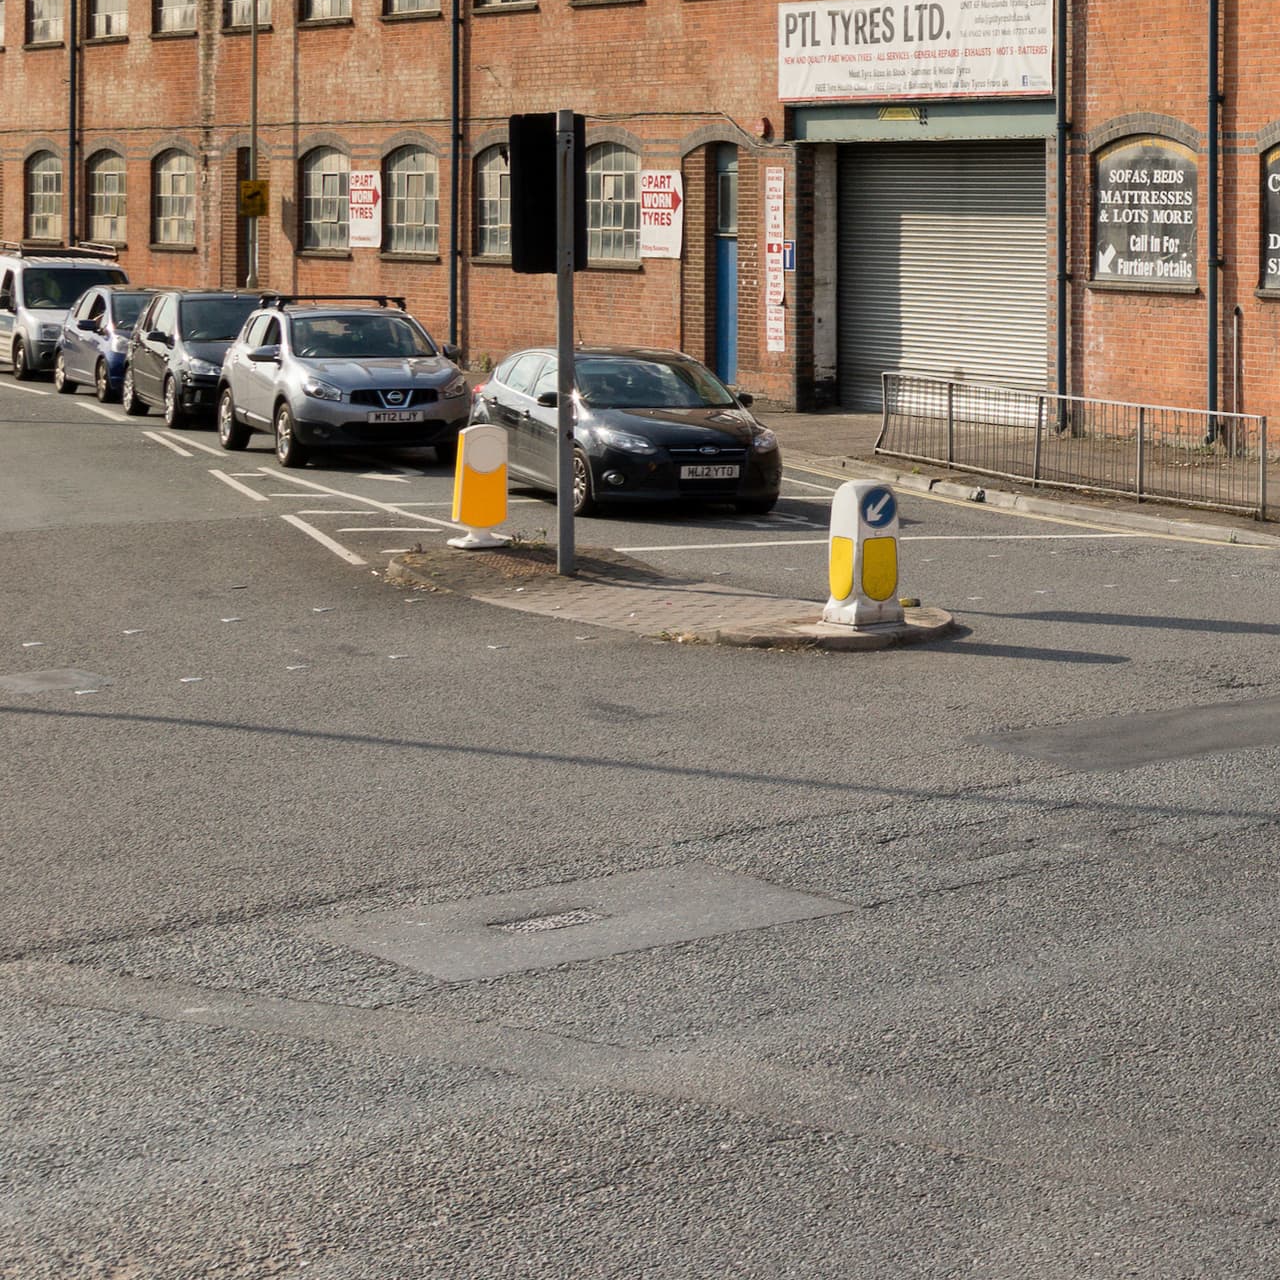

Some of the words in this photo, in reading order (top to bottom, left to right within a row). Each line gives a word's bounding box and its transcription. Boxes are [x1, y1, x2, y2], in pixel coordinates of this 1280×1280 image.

[785, 11, 821, 48] PTL
[827, 6, 895, 46] TYRES
[904, 3, 951, 43] LTD.
[355, 175, 373, 187] PART
[648, 175, 672, 189] PART
[1109, 170, 1150, 186] SOFAS,
[1153, 170, 1184, 184] BEDS
[644, 193, 672, 208] WORN
[1101, 191, 1193, 206] MATTRESSES
[350, 207, 373, 219] TYRES
[642, 212, 672, 226] TYRES
[1100, 210, 1109, 223] &
[1113, 210, 1149, 224] LOTS
[1152, 210, 1193, 224] MORE
[1130, 235, 1148, 252] Call
[1164, 236, 1181, 253] For
[1117, 259, 1154, 276] Further
[1157, 260, 1193, 277] Details
